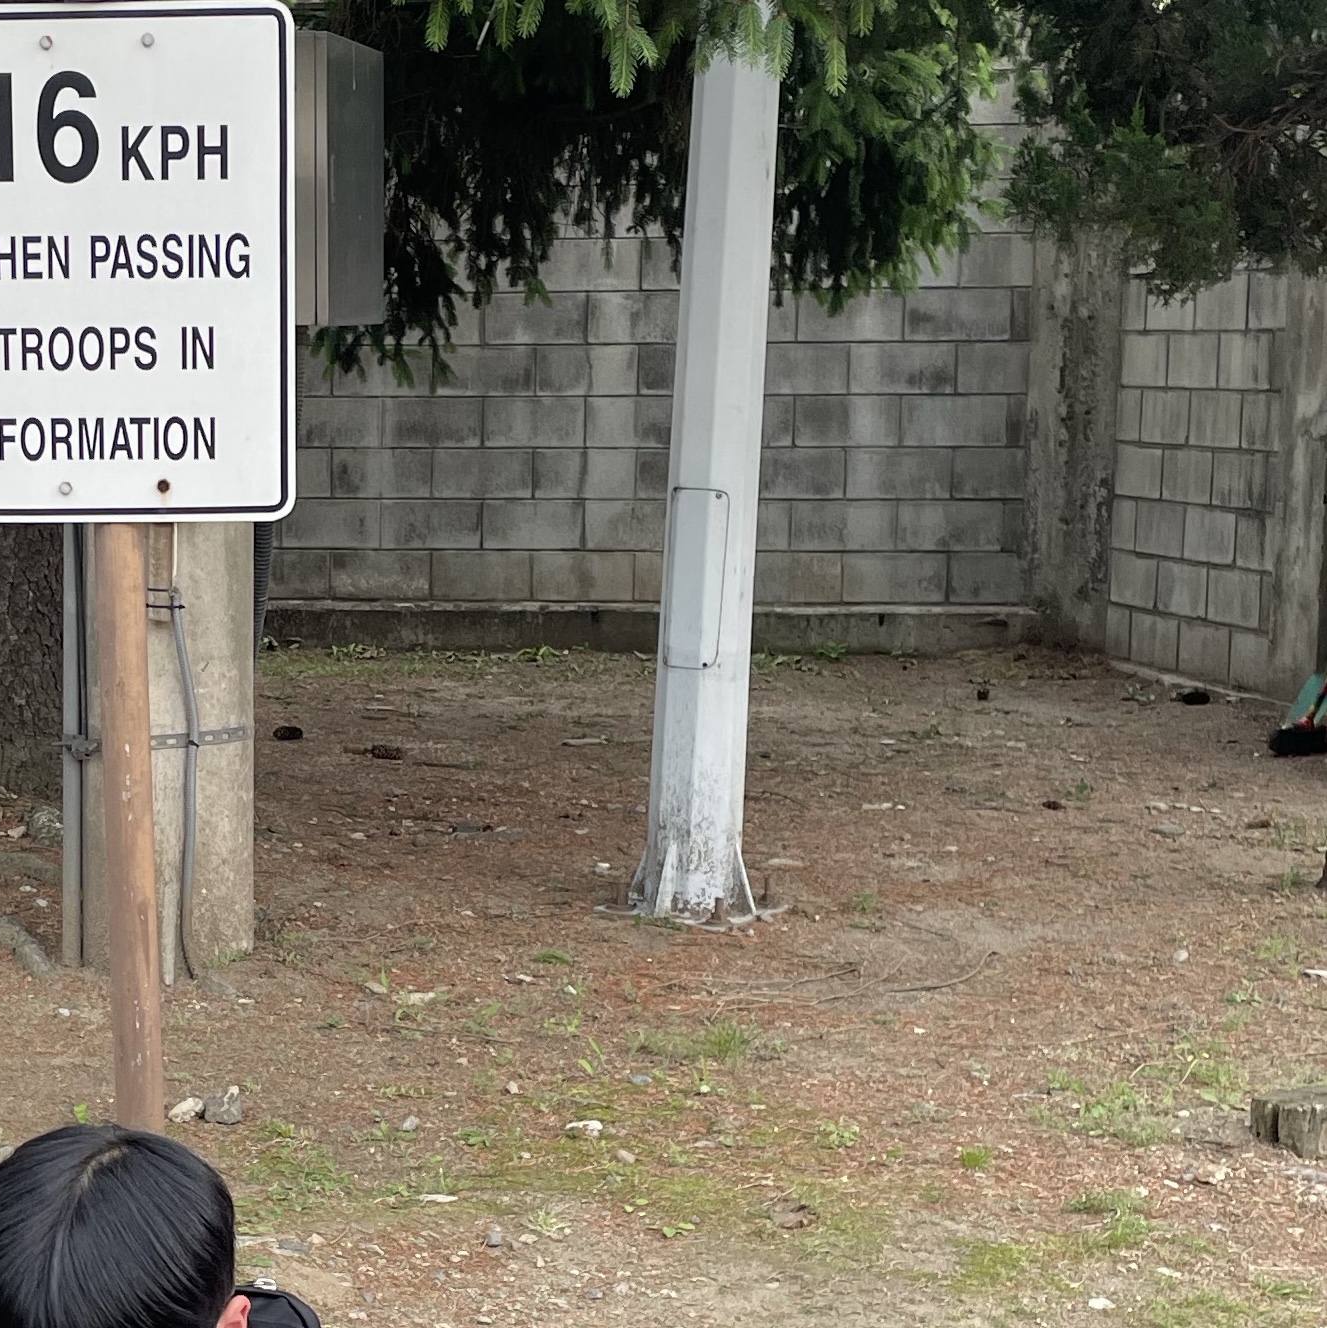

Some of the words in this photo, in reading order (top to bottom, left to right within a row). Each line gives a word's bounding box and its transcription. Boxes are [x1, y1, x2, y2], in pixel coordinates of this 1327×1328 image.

[120, 124, 229, 181] KPH
[90, 232, 251, 280] PASSING
[181, 325, 215, 370] IN
